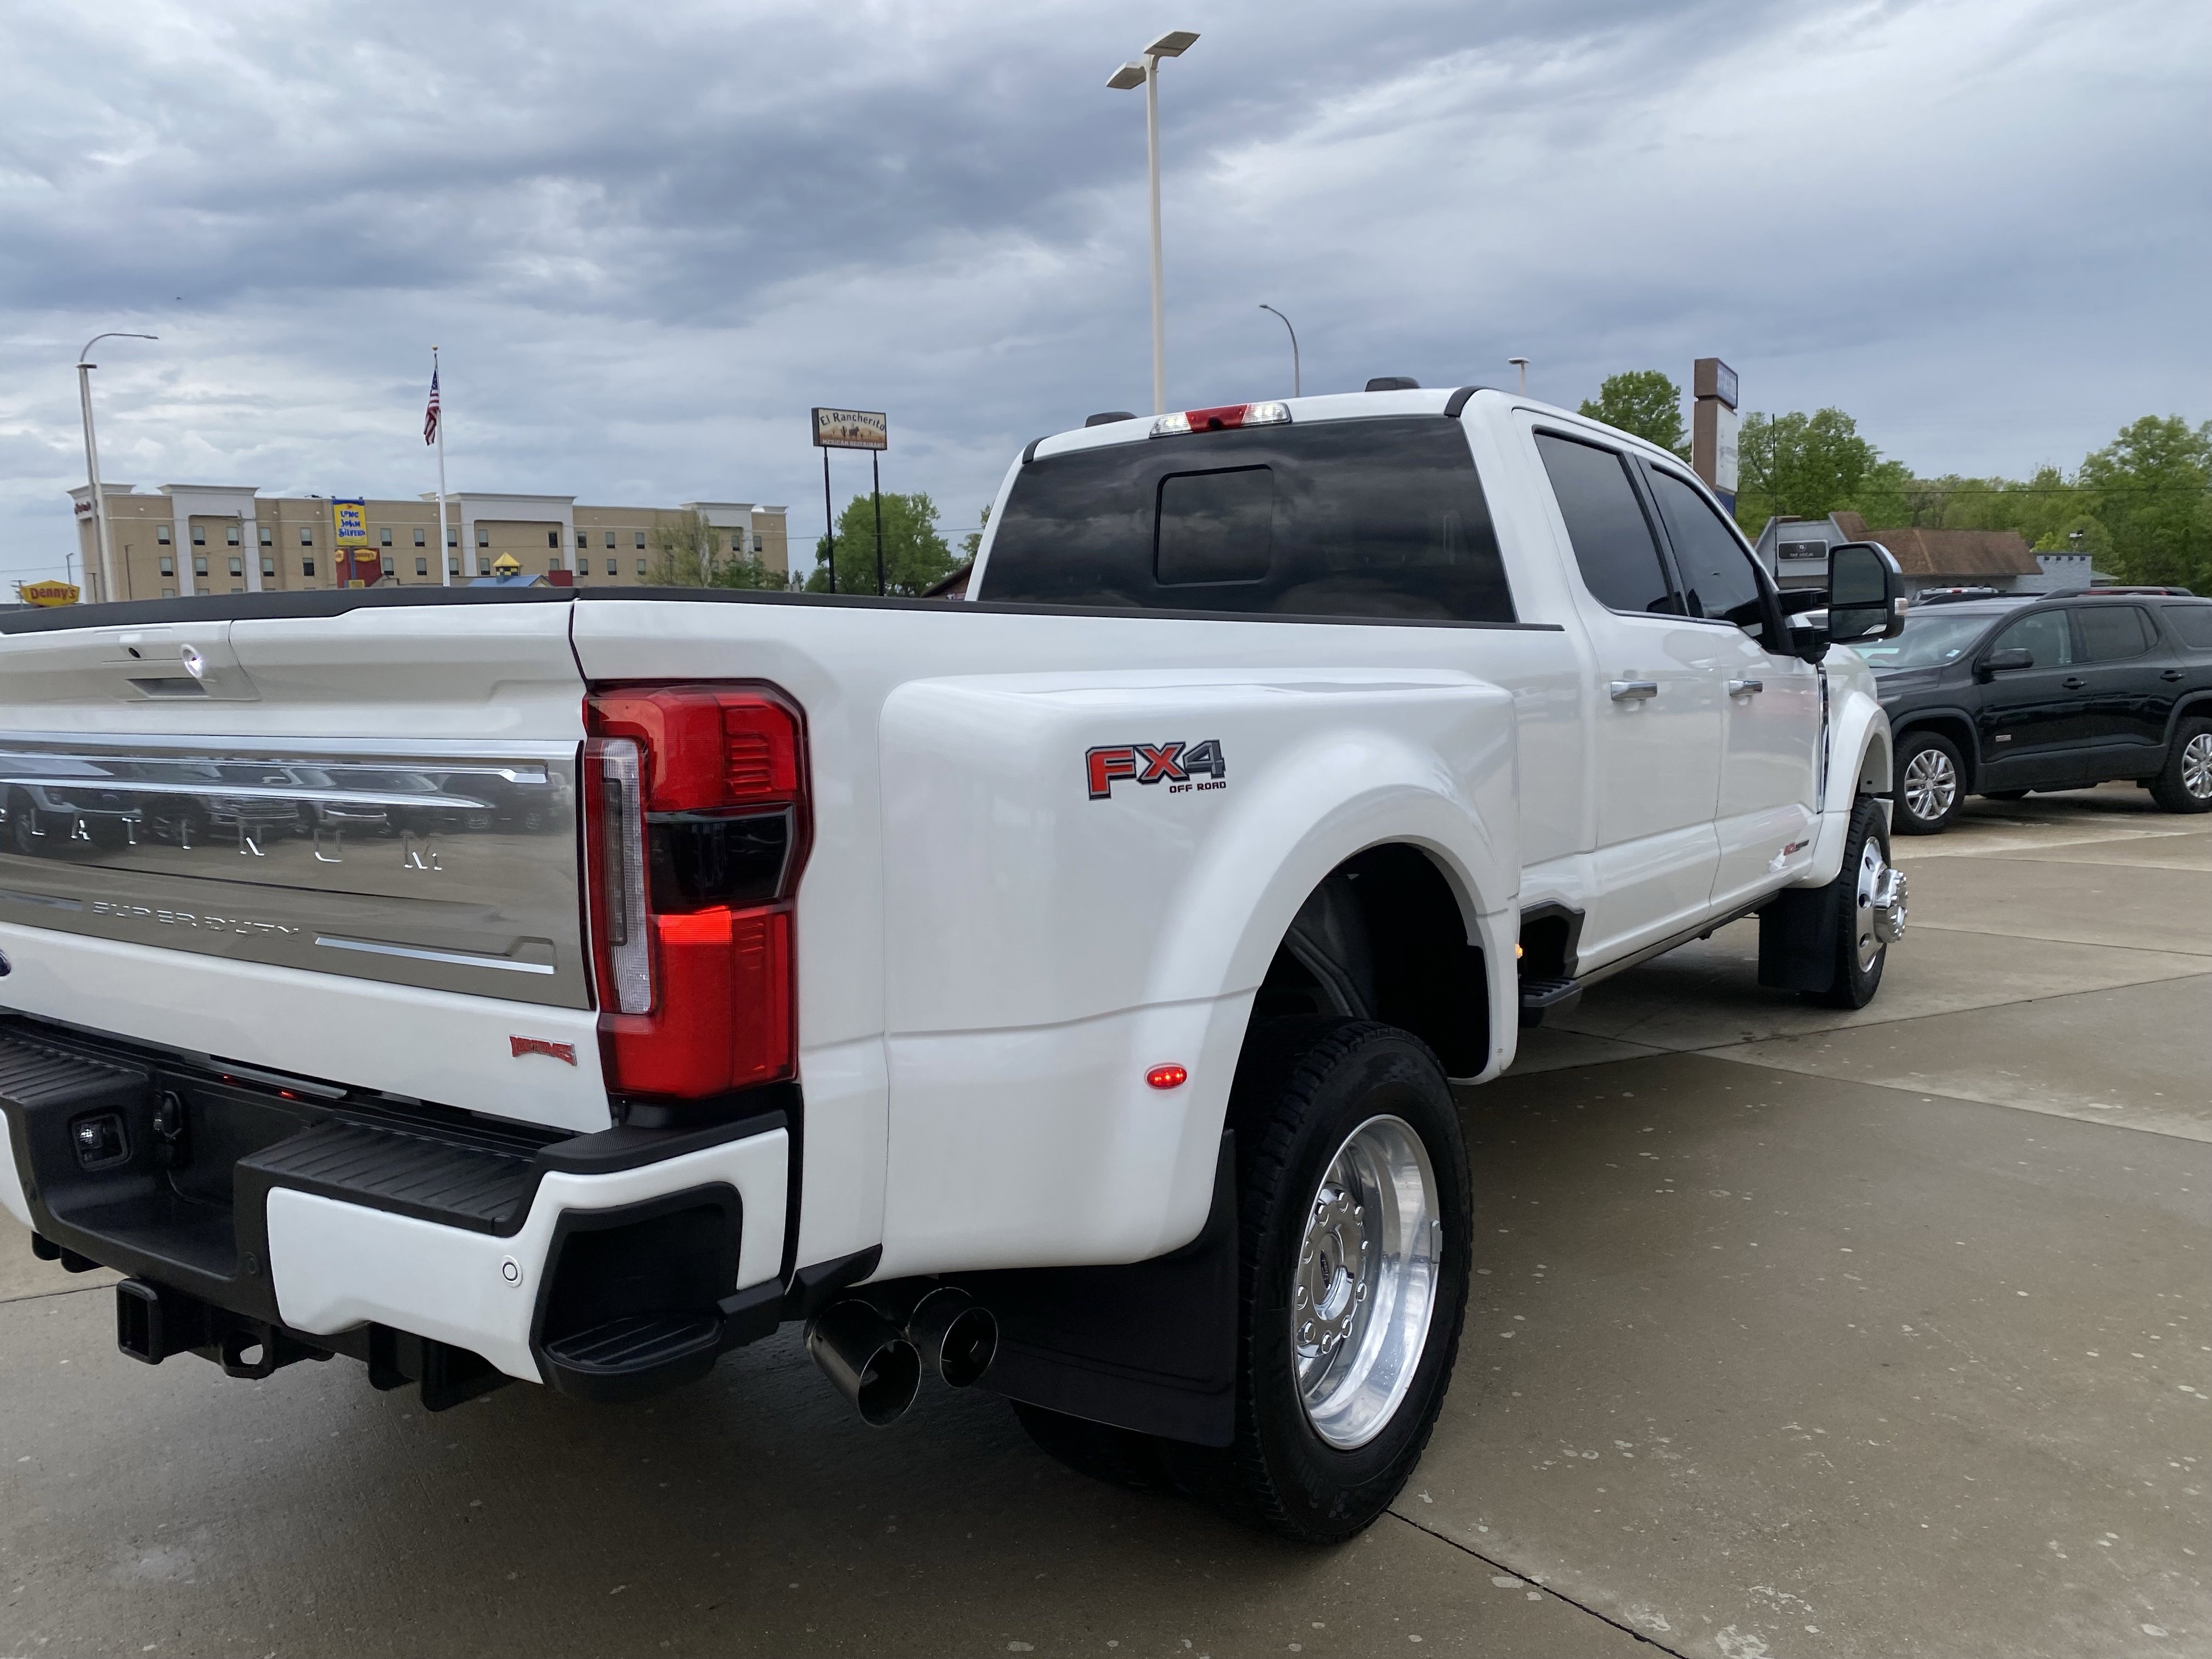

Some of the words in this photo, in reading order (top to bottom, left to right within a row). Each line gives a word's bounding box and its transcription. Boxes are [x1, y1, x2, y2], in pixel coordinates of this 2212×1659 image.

[820, 415, 831, 426] El
[833, 412, 885, 431] Rancherito
[29, 587, 75, 600] Denny's
[1085, 739, 1226, 801] FX4
[1169, 784, 1193, 793] OFF
[1197, 781, 1227, 791] ROAD
[0, 806, 443, 871] LATINUM
[93, 901, 198, 927] SUPER
